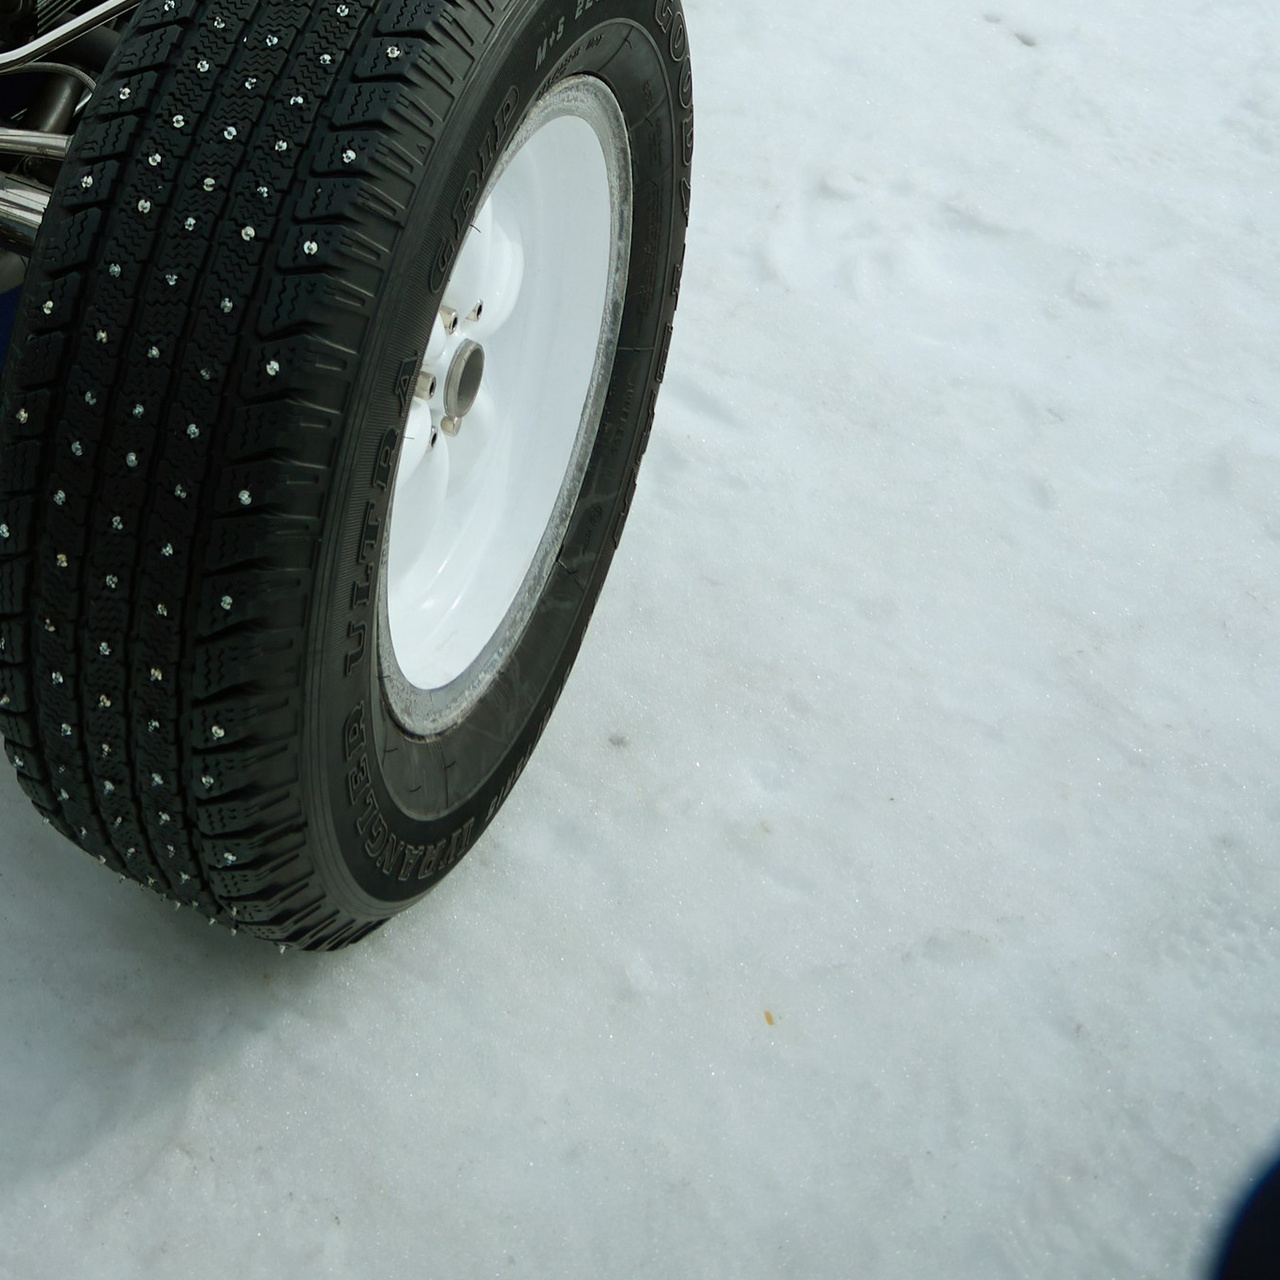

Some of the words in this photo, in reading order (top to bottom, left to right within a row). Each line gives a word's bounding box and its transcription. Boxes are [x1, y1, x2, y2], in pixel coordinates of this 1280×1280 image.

[534, 16, 566, 71] M+S
[344, 349, 419, 677] ULTRA
[428, 85, 520, 294] GRIP
